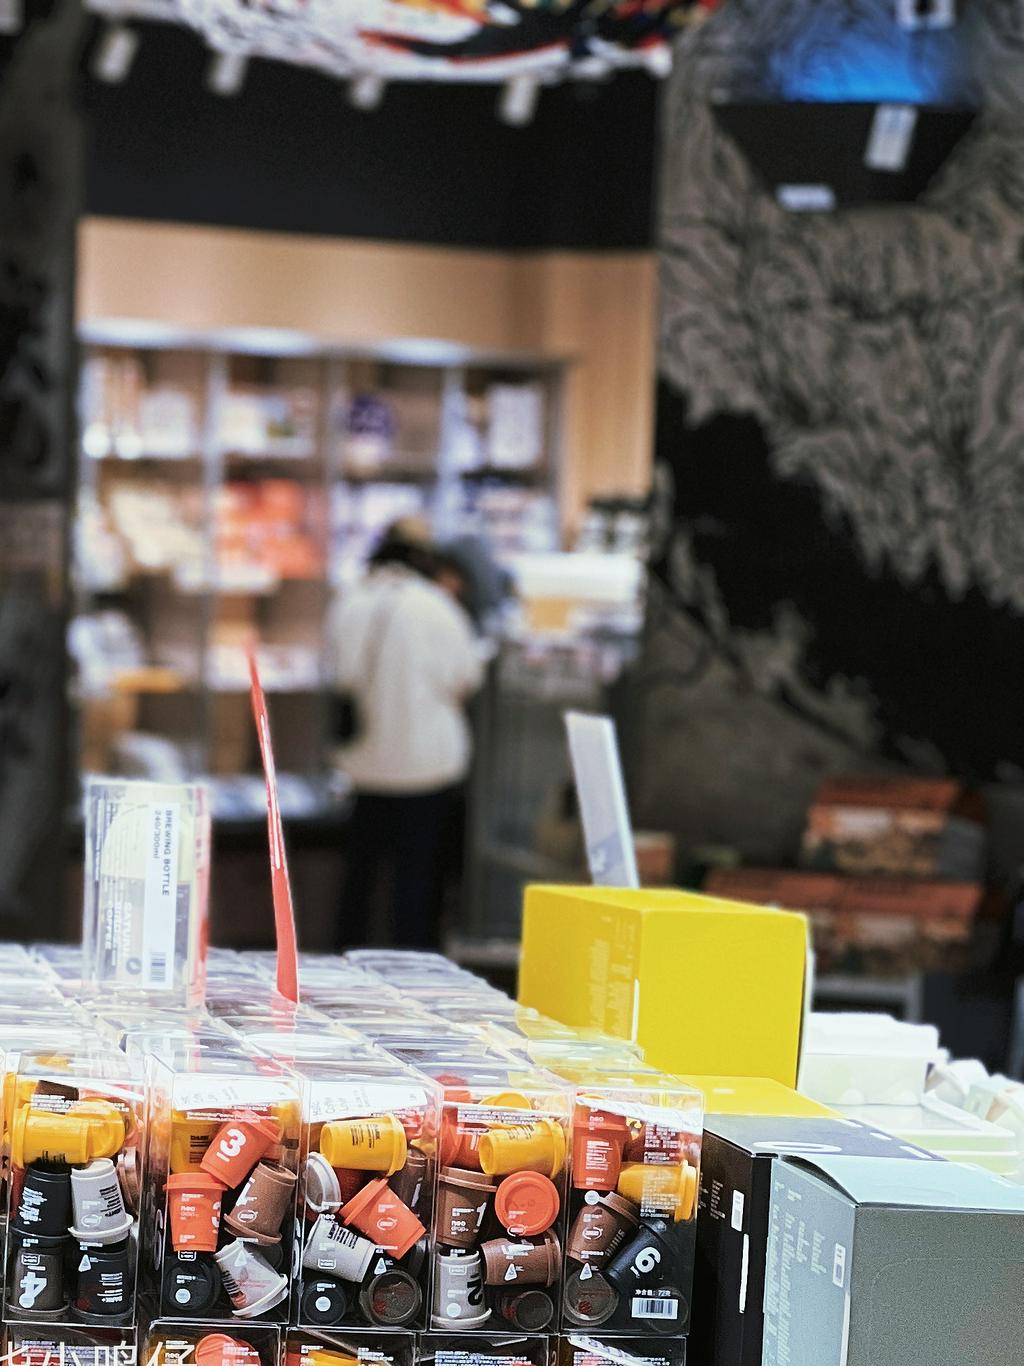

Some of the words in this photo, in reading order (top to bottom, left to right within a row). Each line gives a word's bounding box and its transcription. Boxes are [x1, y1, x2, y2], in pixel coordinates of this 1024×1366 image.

[163, 809, 173, 855] BREWING
[162, 858, 171, 896] BOTTLE
[219, 1128, 247, 1158] 3
[635, 1246, 661, 1273] 6
